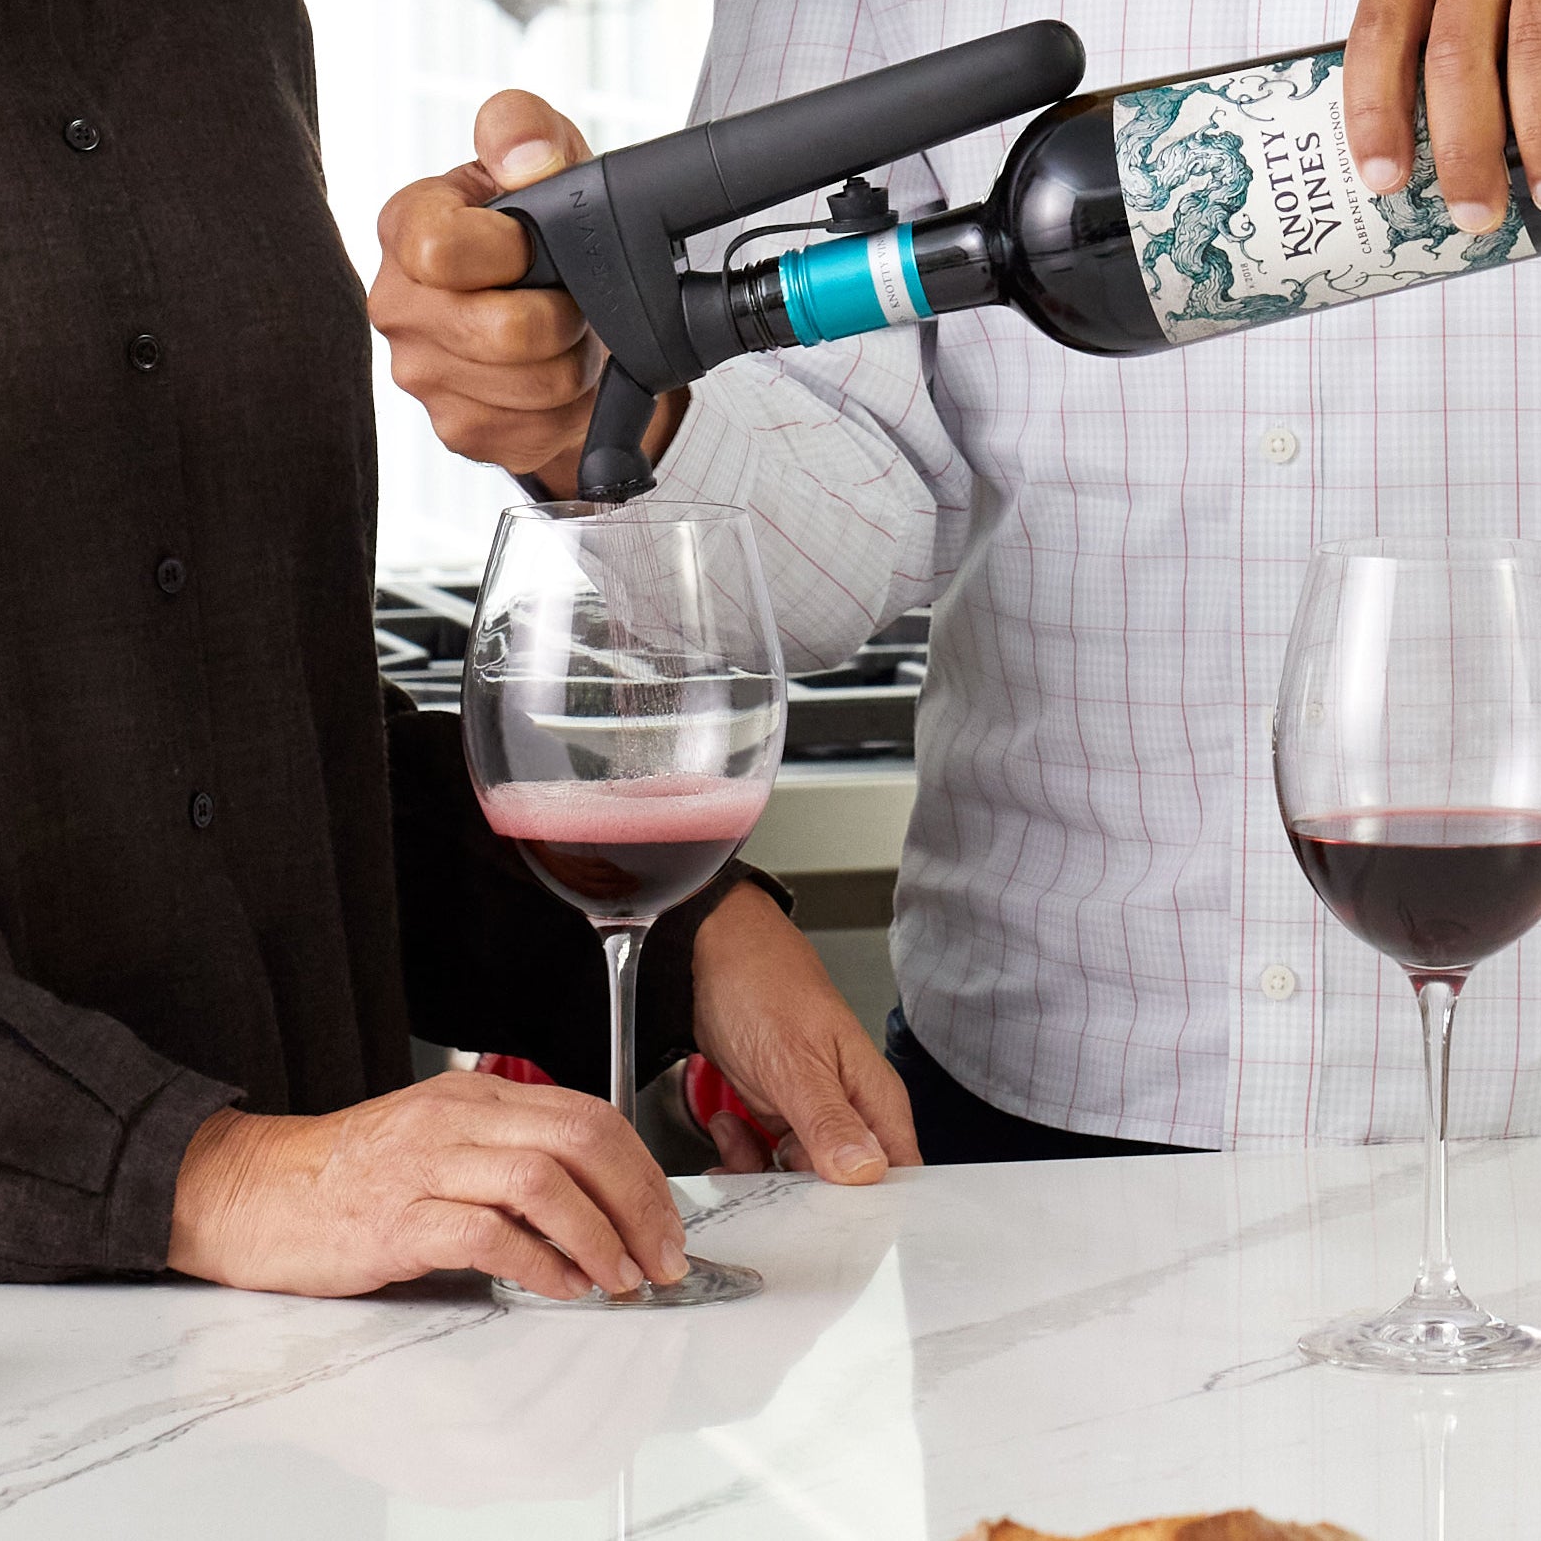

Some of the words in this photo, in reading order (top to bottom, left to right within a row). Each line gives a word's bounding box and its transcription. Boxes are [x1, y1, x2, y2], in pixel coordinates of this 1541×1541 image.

[1328, 101, 1353, 184] SAUVIGNON
[1261, 130, 1313, 261] KNOTTY
[1295, 131, 1342, 254] VINES
[1346, 189, 1372, 255] CABERNET
[880, 261, 900, 310] KNOTTY
[1240, 263, 1253, 283] 2018
